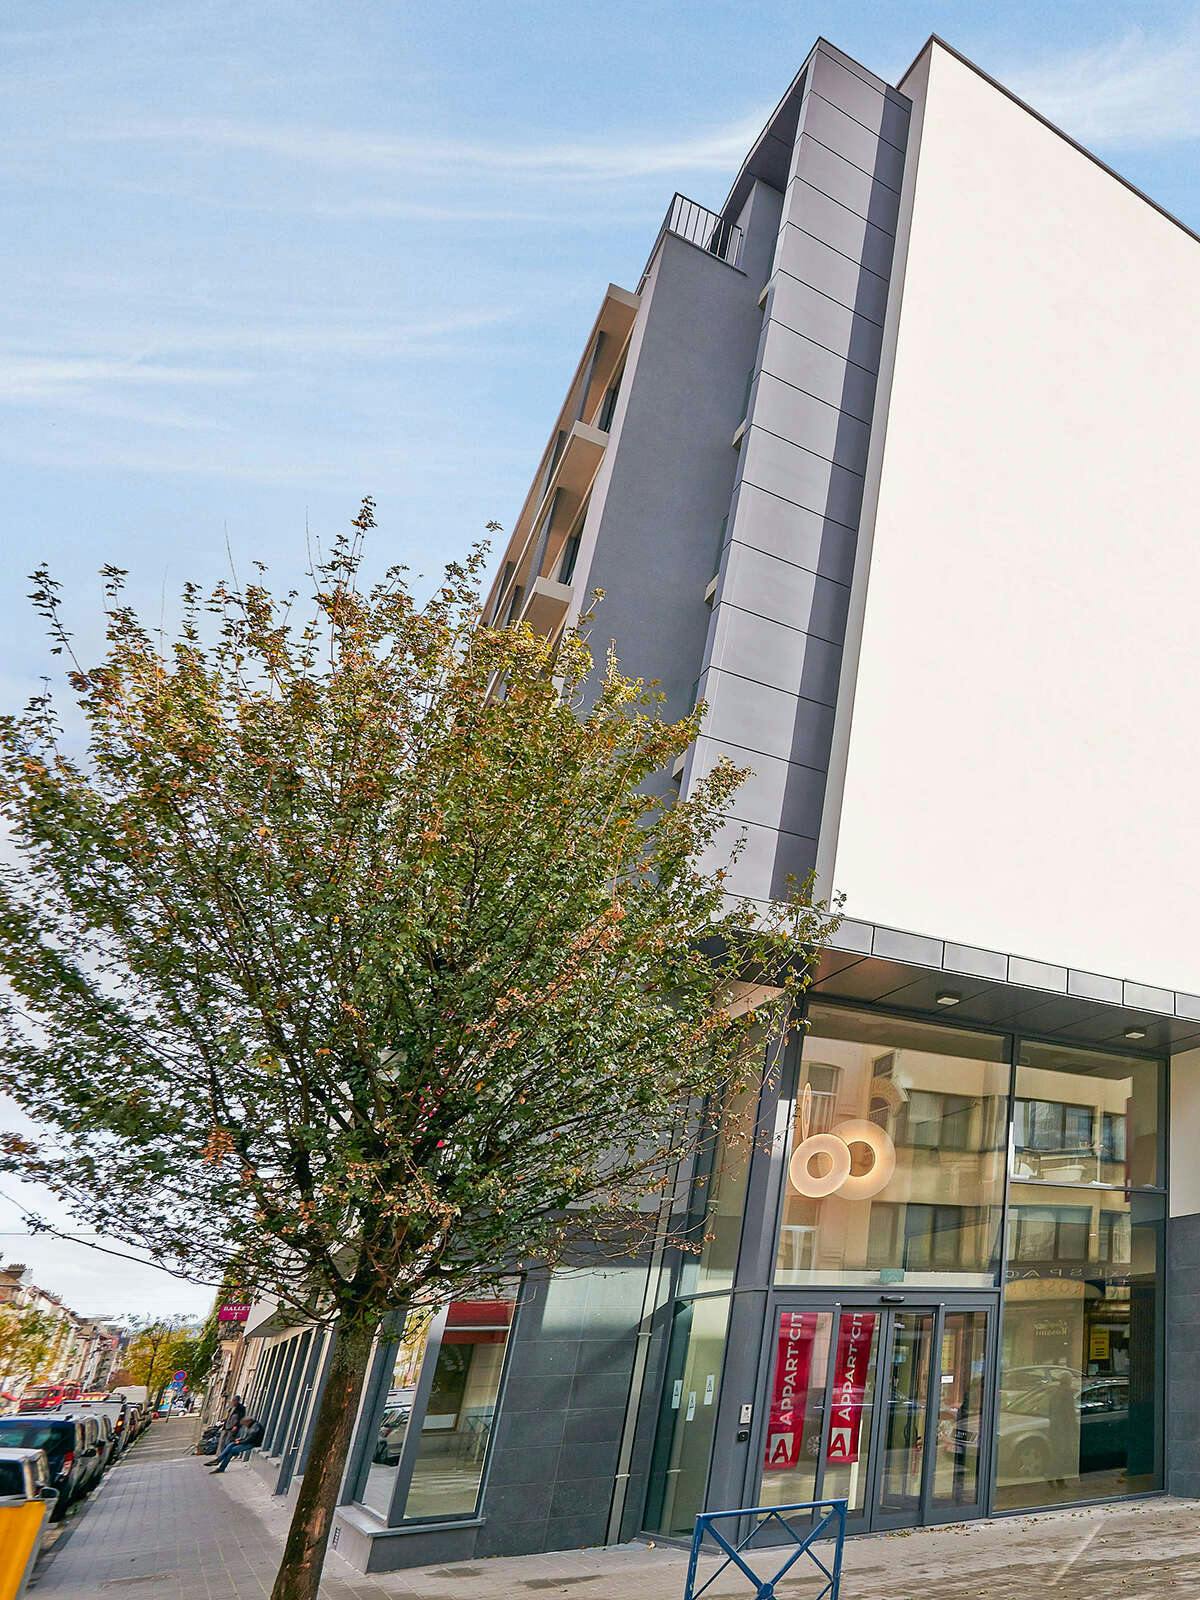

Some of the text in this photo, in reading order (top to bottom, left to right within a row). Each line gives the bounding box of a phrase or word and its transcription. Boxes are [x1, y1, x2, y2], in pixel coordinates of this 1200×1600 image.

[780, 1312, 803, 1425] APPART'CIT
[838, 1313, 863, 1421] APPART'CIT
[769, 1437, 791, 1464] A
